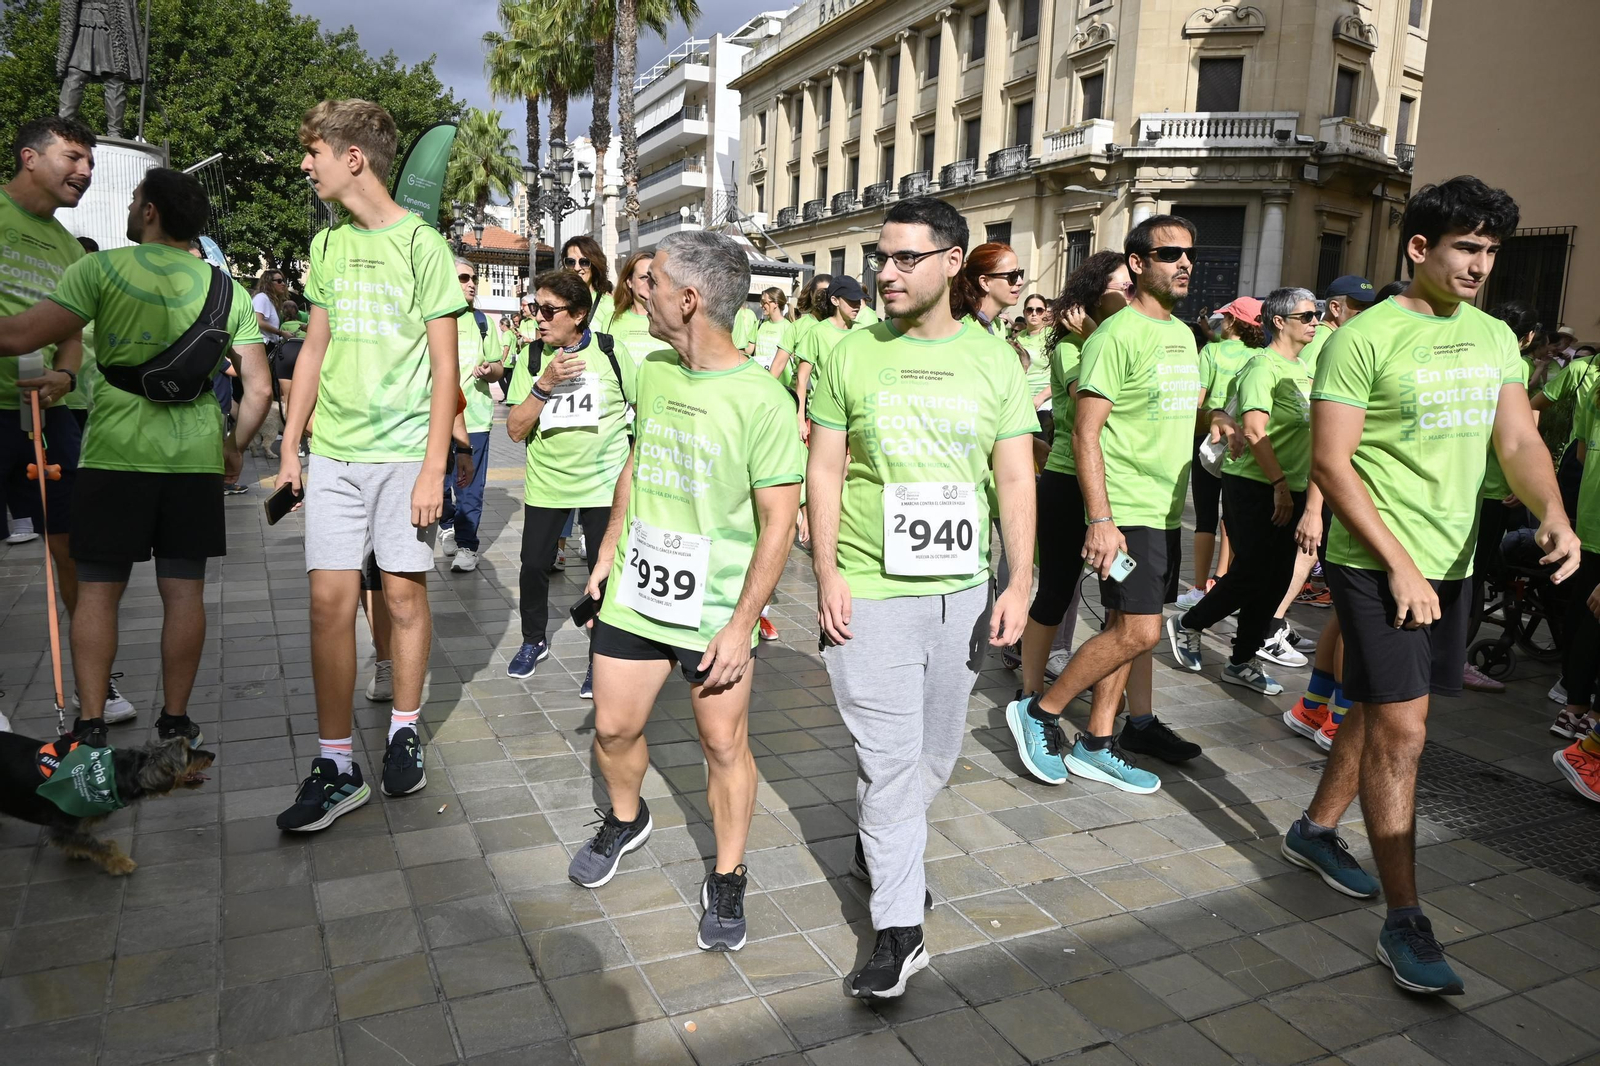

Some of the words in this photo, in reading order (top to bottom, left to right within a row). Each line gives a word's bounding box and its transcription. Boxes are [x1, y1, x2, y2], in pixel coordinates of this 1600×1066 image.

[819, 0, 857, 26] BAN
[403, 194, 431, 210] Tenemos
[2, 245, 20, 261] En
[24, 254, 64, 276] march
[383, 301, 402, 318] el
[930, 369, 955, 377] española
[1157, 364, 1172, 374] En
[1174, 364, 1201, 374] marc
[1417, 368, 1441, 384] En
[1161, 379, 1196, 392] contra
[687, 405, 708, 415] española
[877, 390, 902, 407] En
[906, 394, 979, 413] marcha
[1398, 371, 1418, 442] HUELVA
[876, 413, 952, 433] contra
[954, 417, 977, 436] el
[645, 418, 662, 436] En
[664, 426, 722, 457] marcha
[880, 431, 977, 460] cáncer
[640, 442, 693, 470] contra
[694, 458, 714, 477] el
[637, 461, 711, 498] cáncer
